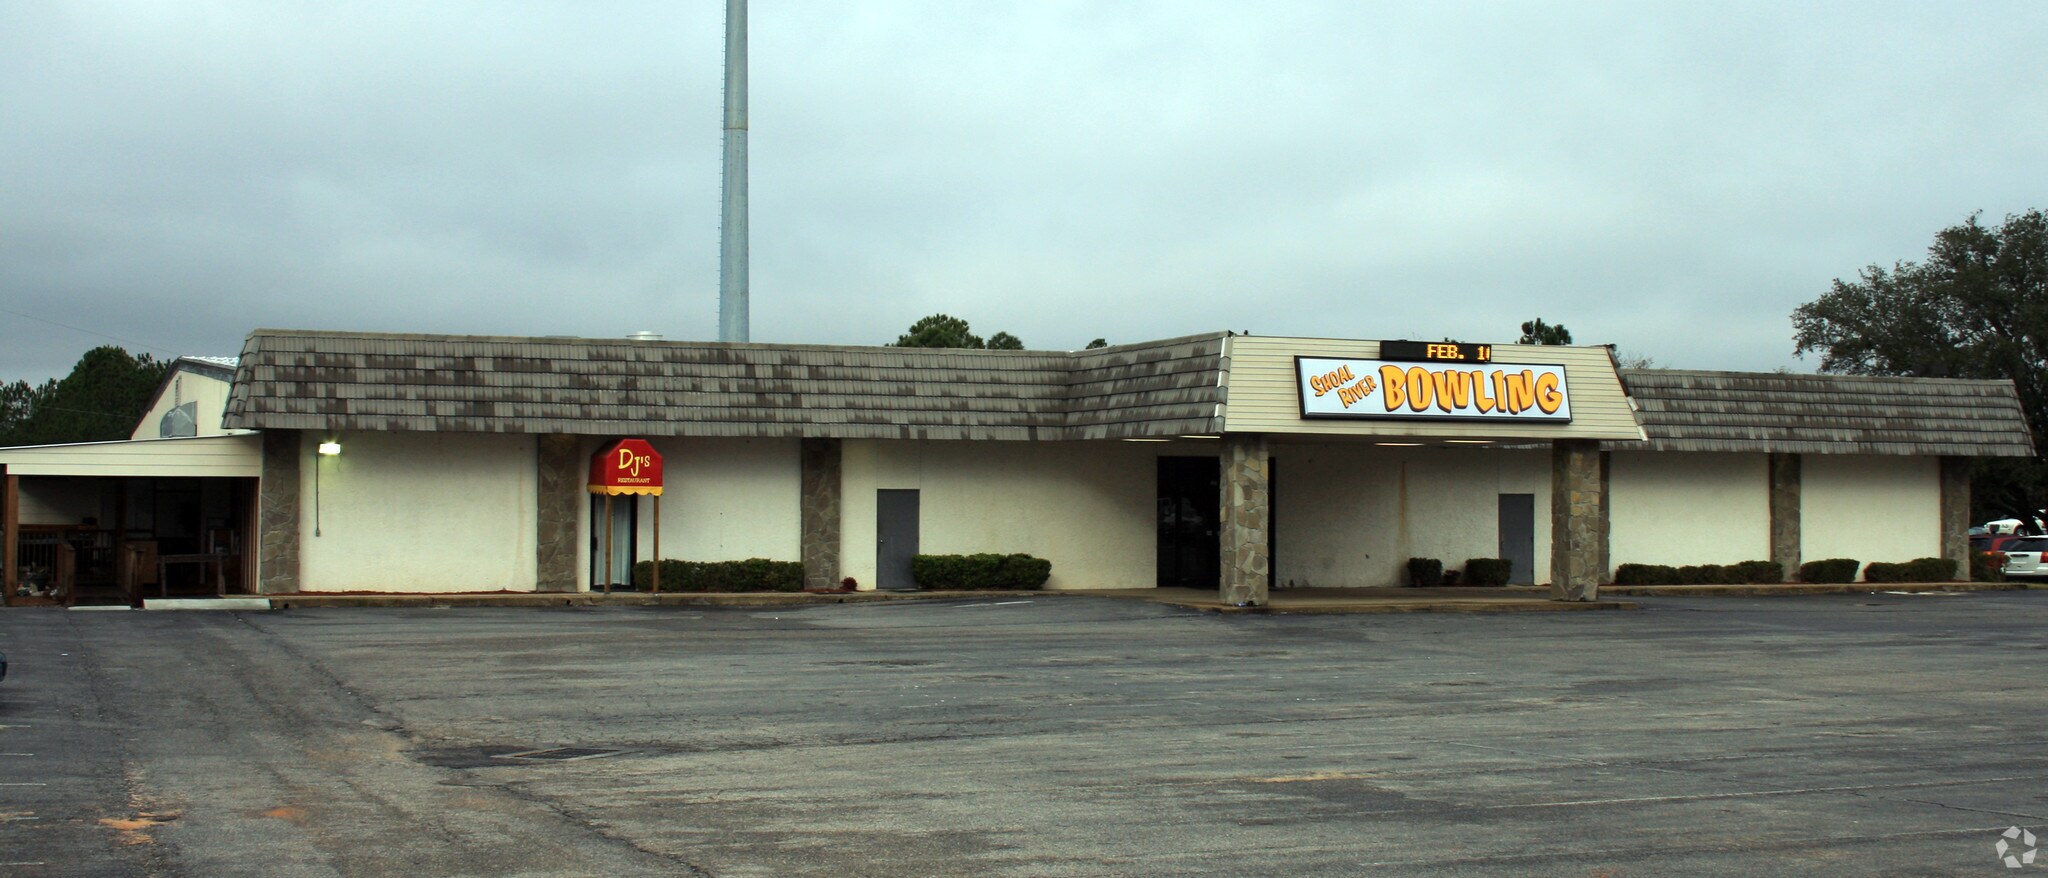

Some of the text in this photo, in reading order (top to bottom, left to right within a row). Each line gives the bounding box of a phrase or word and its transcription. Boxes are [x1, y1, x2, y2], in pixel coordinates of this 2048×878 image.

[1426, 344, 1465, 360] FEB.
[1309, 364, 1356, 398] SHOAL
[1337, 375, 1378, 409] RIVER
[1378, 364, 1563, 416] BOWLING
